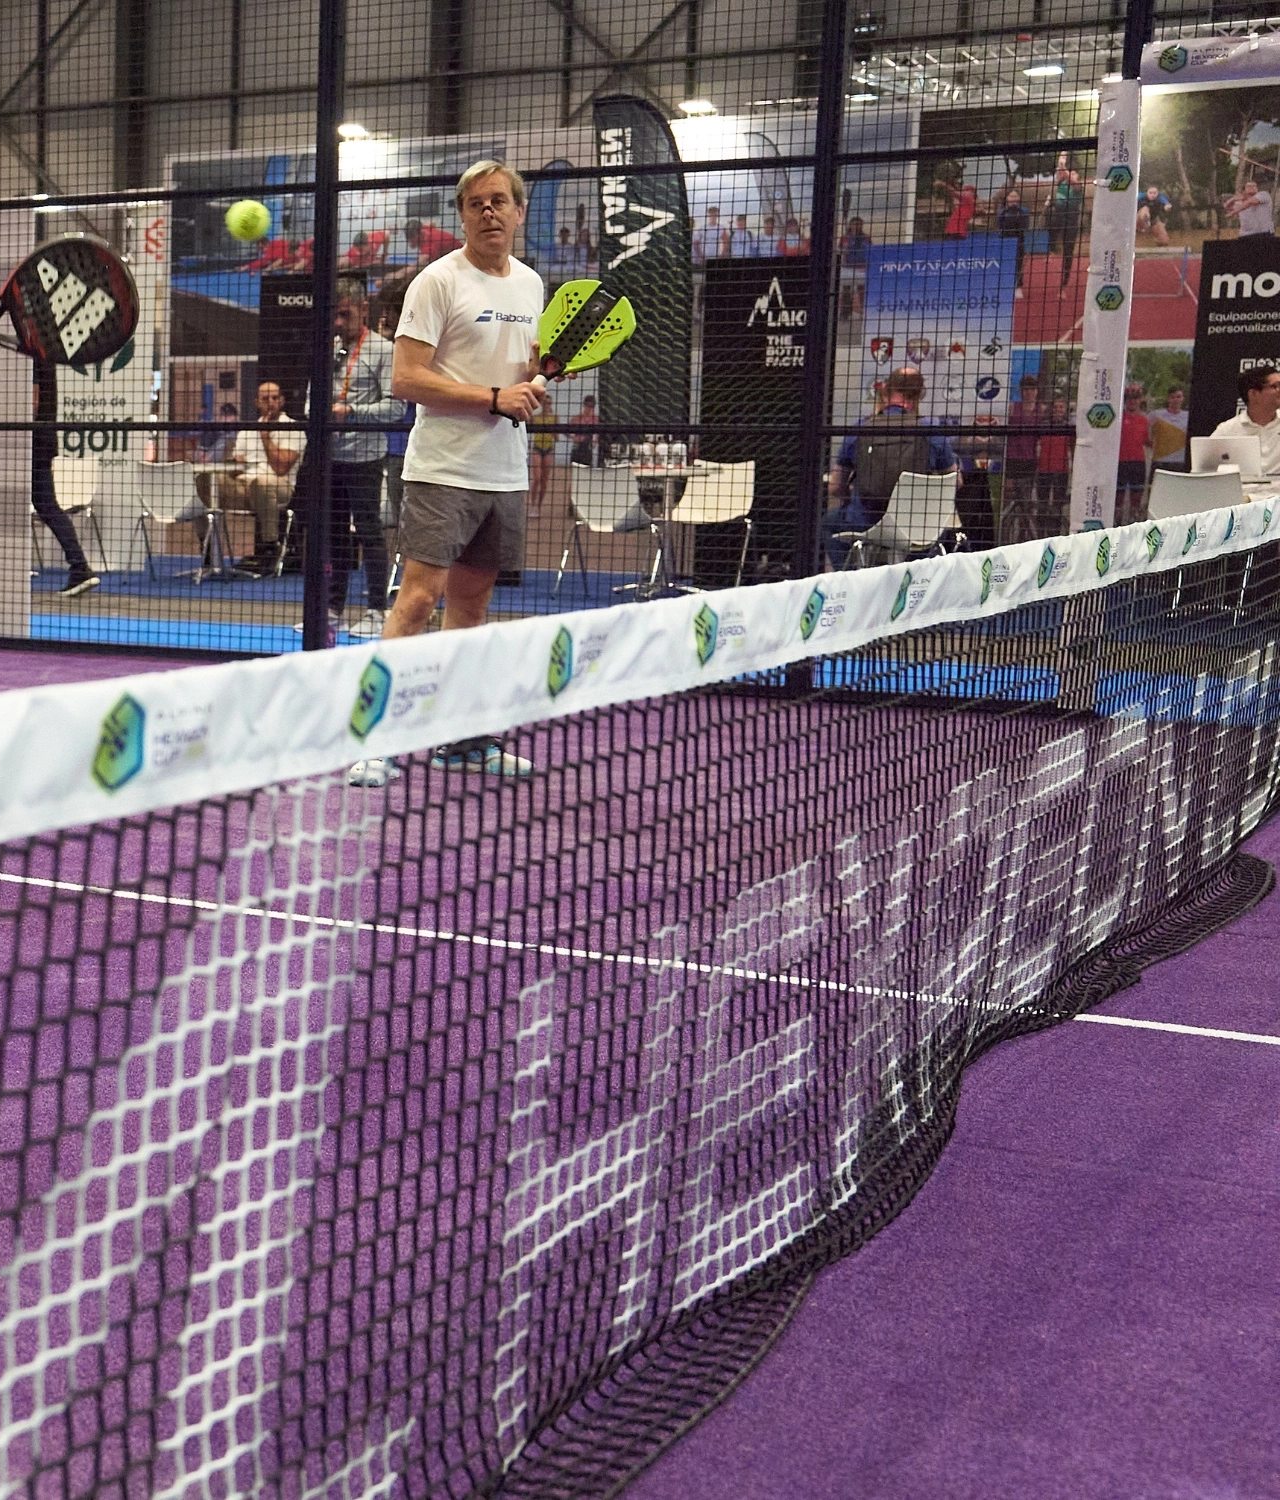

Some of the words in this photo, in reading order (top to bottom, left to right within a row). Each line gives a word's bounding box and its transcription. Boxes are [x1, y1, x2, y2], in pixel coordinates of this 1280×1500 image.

[1117, 129, 1125, 163] HEXAGON
[1109, 250, 1117, 283] HEXAGON
[1210, 271, 1280, 300] mo
[876, 300, 951, 313] SUMMER
[63, 394, 107, 411] Región
[111, 395, 126, 407] de
